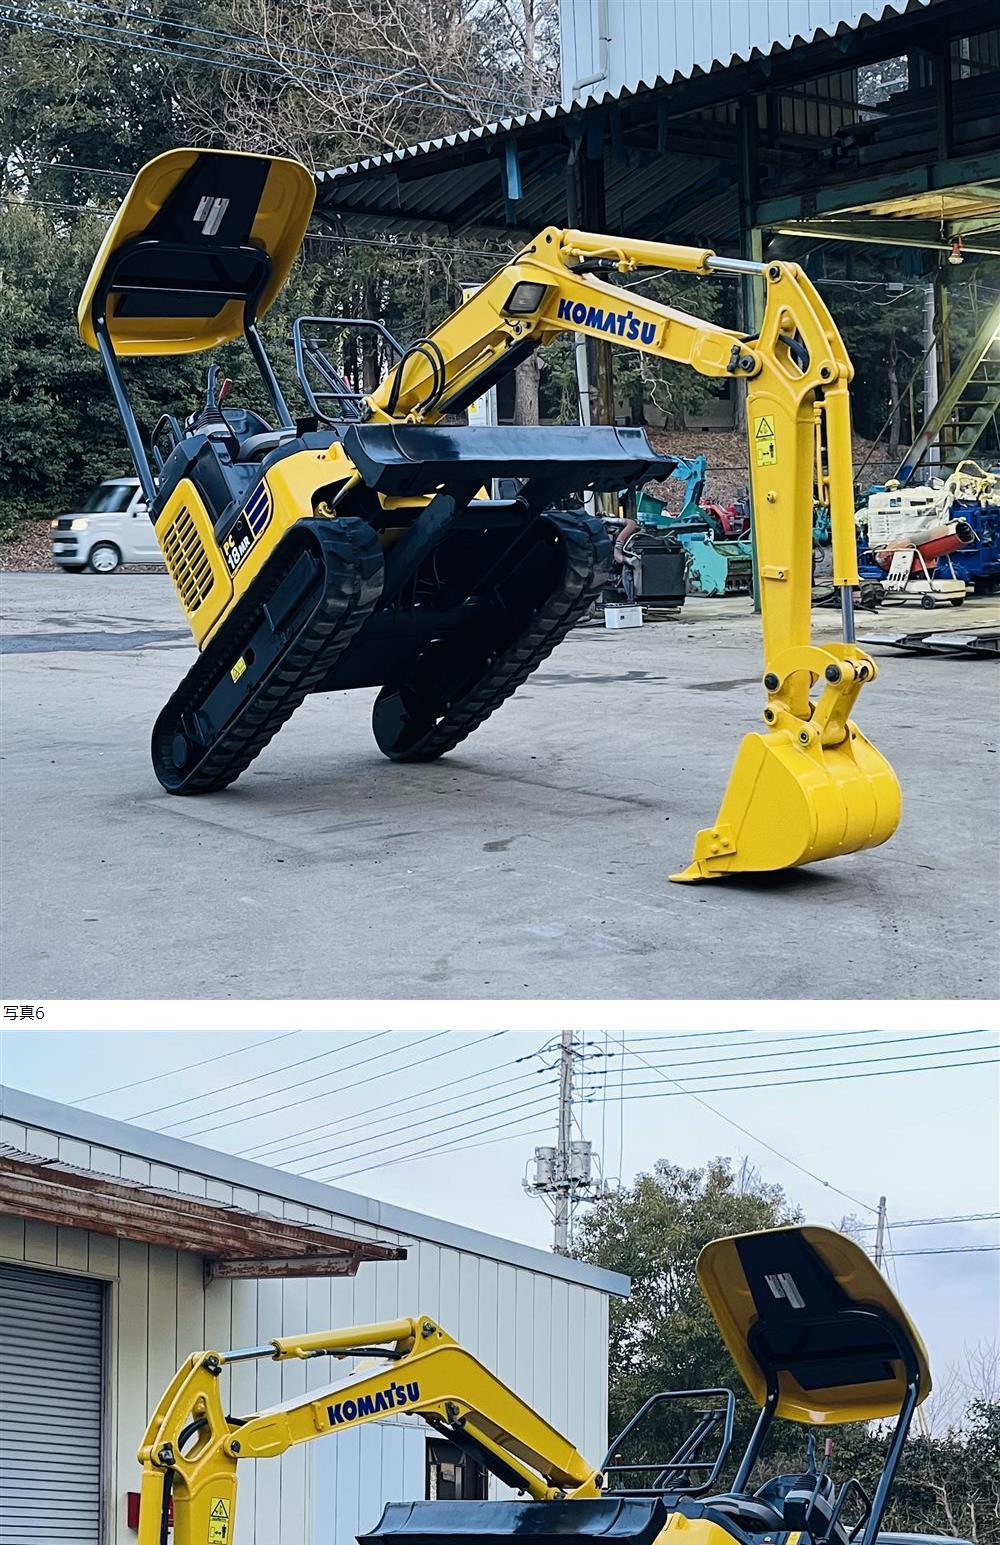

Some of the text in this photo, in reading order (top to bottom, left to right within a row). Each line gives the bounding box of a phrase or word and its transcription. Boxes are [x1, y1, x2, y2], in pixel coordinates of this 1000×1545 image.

[557, 298, 656, 345] KOMATSU
[223, 535, 235, 556] PC
[327, 1381, 420, 1426] KOMATSU
